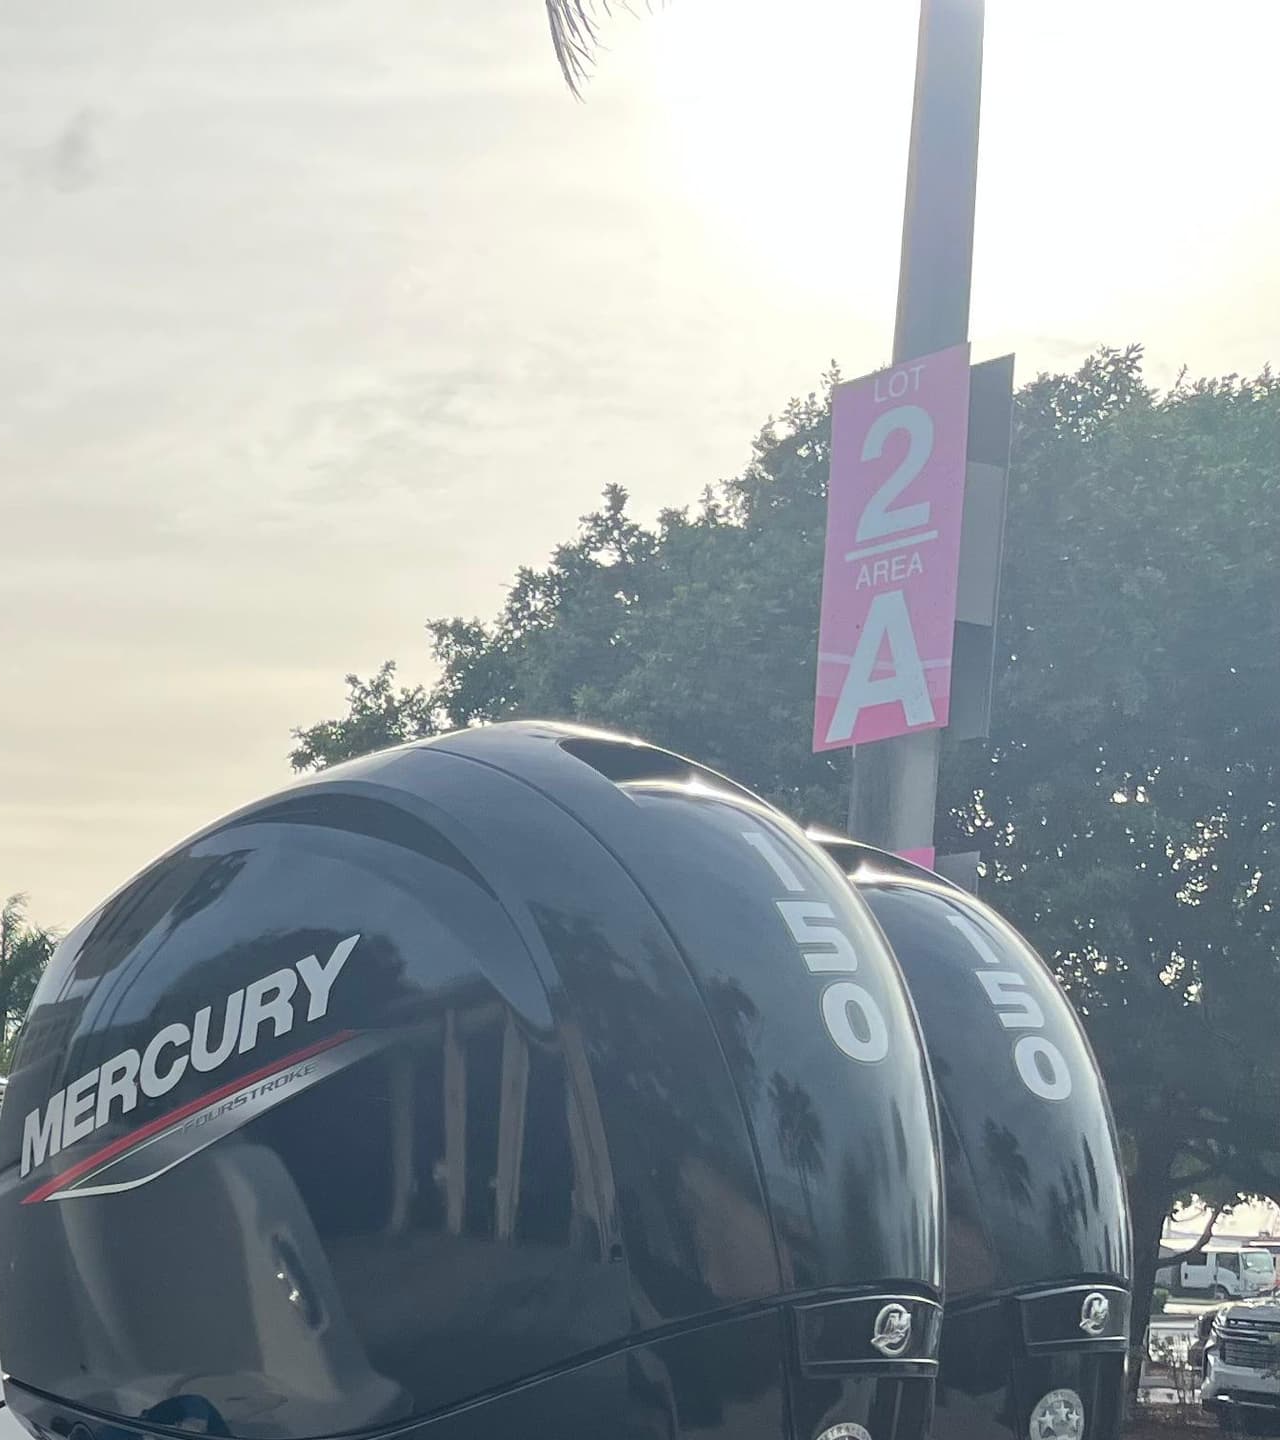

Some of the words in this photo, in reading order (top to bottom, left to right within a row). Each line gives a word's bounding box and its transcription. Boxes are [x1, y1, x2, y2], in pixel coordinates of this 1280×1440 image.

[874, 364, 926, 402] LOT
[856, 404, 935, 544] 2
[855, 551, 924, 591] AREA
[825, 589, 937, 744] A
[740, 831, 890, 1065] 150
[945, 914, 1073, 1102] 150
[20, 933, 361, 1179] MERCURY
